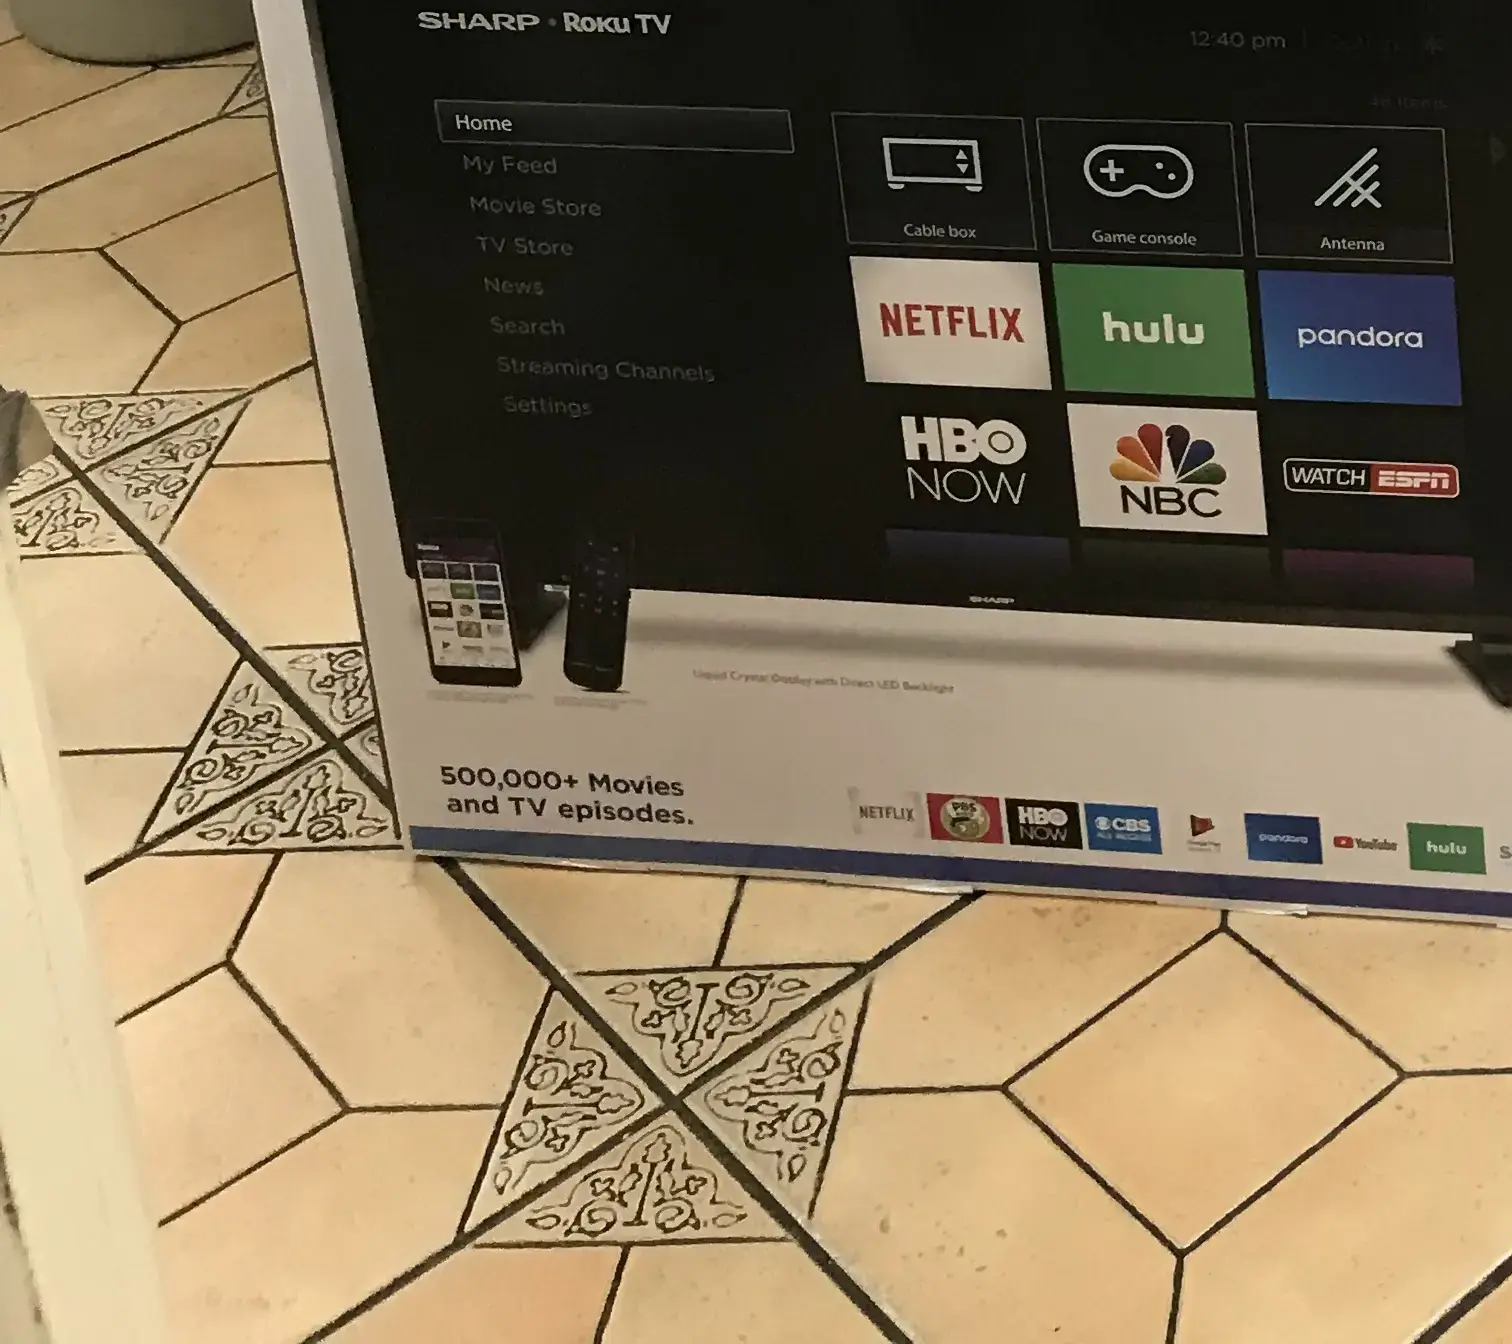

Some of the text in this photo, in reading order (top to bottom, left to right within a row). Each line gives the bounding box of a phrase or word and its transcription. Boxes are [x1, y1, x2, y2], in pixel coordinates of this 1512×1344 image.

[418, 11, 672, 34] SHARP Roku TV
[1190, 30, 1287, 53] 12:40 pm
[455, 114, 513, 132] Home
[463, 155, 558, 176] My Feed
[470, 195, 602, 217] Movie Store
[903, 222, 977, 240] Cable box
[1091, 229, 1197, 248] Game console
[475, 236, 574, 256] TV Store
[1319, 235, 1385, 252] Antenna
[483, 277, 544, 296] News
[489, 316, 565, 336] Search
[879, 301, 1025, 344] NETFLIX
[1102, 311, 1205, 345] hulu
[1297, 326, 1423, 349] pandora
[496, 356, 716, 382] Streaming Channels
[503, 396, 593, 418] Settings
[900, 415, 1027, 465] HBO
[907, 466, 1027, 505] NOW
[1291, 465, 1451, 490] WATCH ESPN
[1119, 482, 1223, 518] NBC
[439, 765, 685, 798] 500,000+ Movies
[448, 794, 695, 826] and TV episodes.
[859, 804, 915, 822] NETFLIX
[1018, 805, 1068, 828] HBO
[1019, 826, 1067, 842] NOW
[1112, 816, 1152, 833] CBS
[1355, 836, 1399, 852] YouTube
[1425, 839, 1467, 855] hulu
